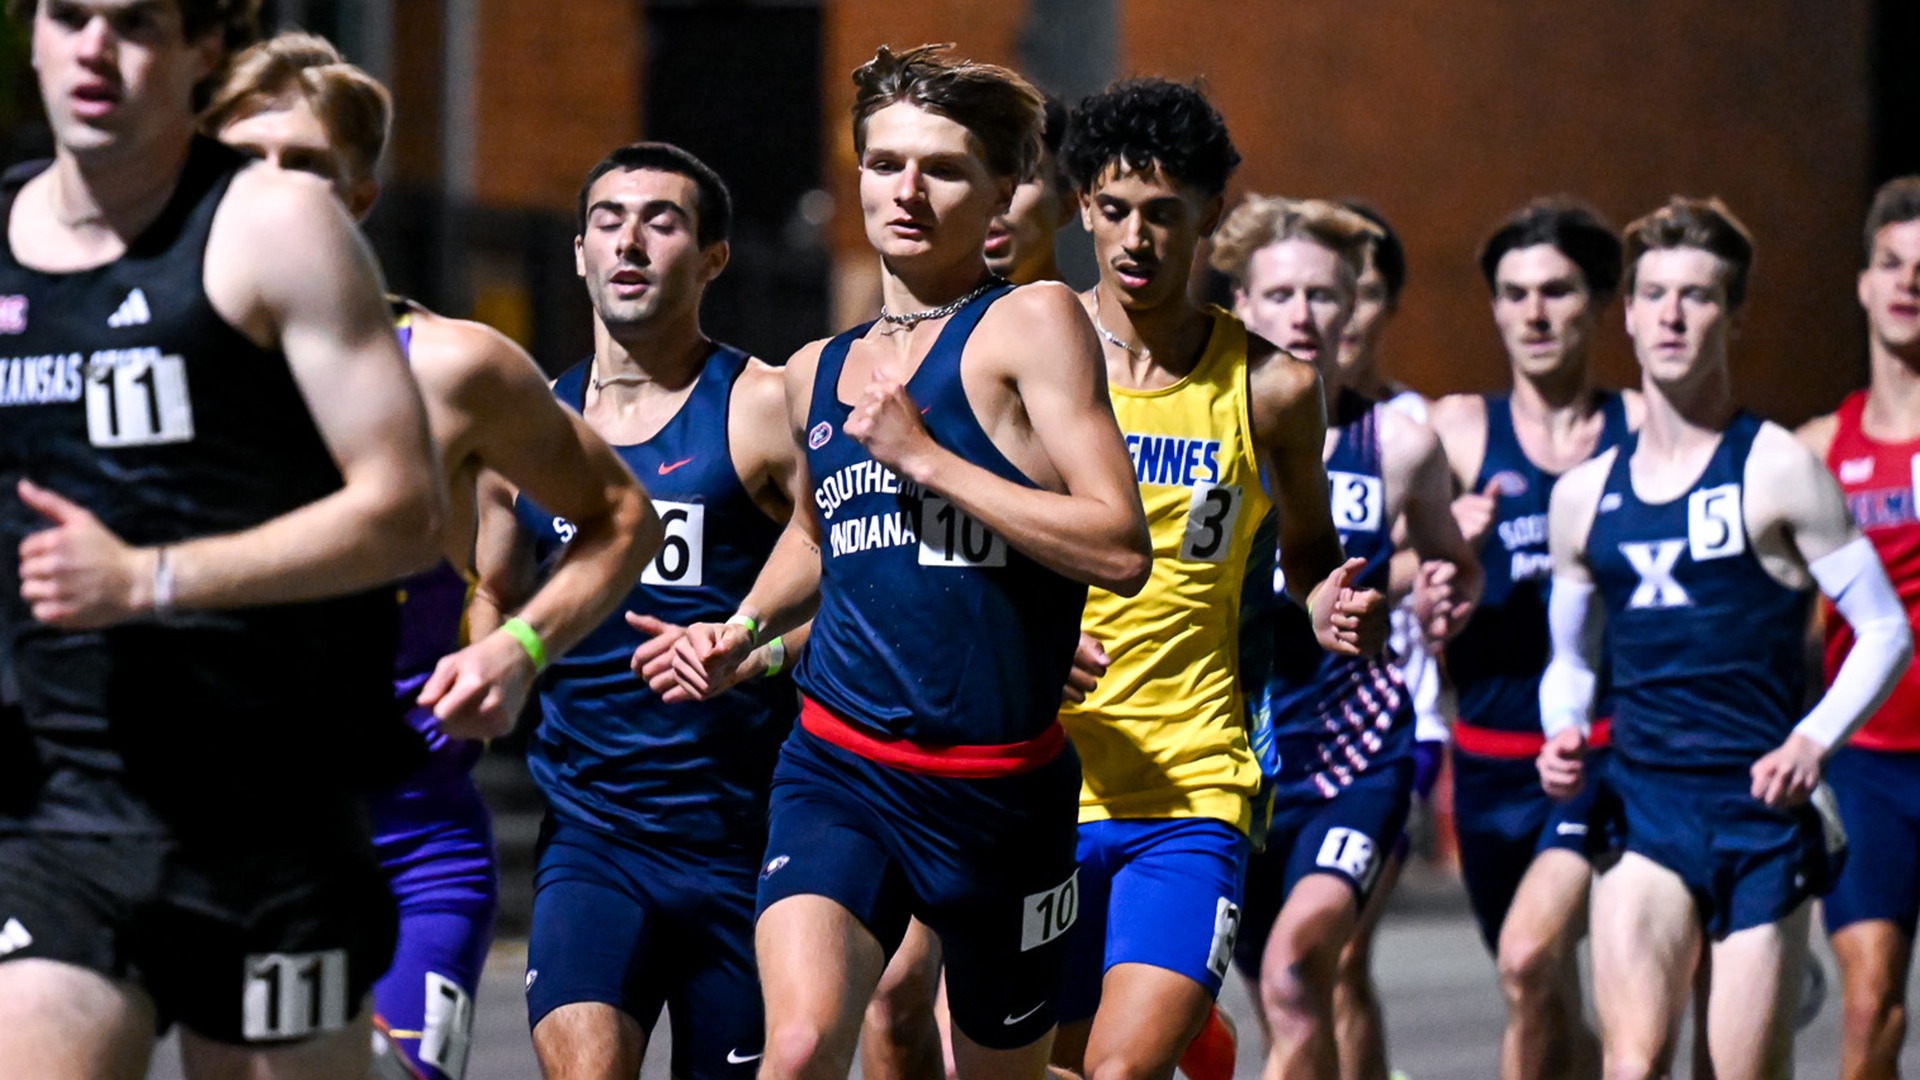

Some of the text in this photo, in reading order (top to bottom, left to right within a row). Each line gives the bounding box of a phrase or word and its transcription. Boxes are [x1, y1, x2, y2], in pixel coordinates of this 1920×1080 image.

[96, 364, 161, 438] 11
[936, 502, 993, 563] 10
[1190, 488, 1232, 559] 3
[1329, 478, 1369, 524] 3
[1705, 494, 1730, 550] 5
[655, 508, 690, 582] 6
[830, 511, 917, 558] INDIANA
[1617, 537, 1698, 609] X
[1036, 879, 1076, 941] 10
[254, 961, 322, 1031] 11
